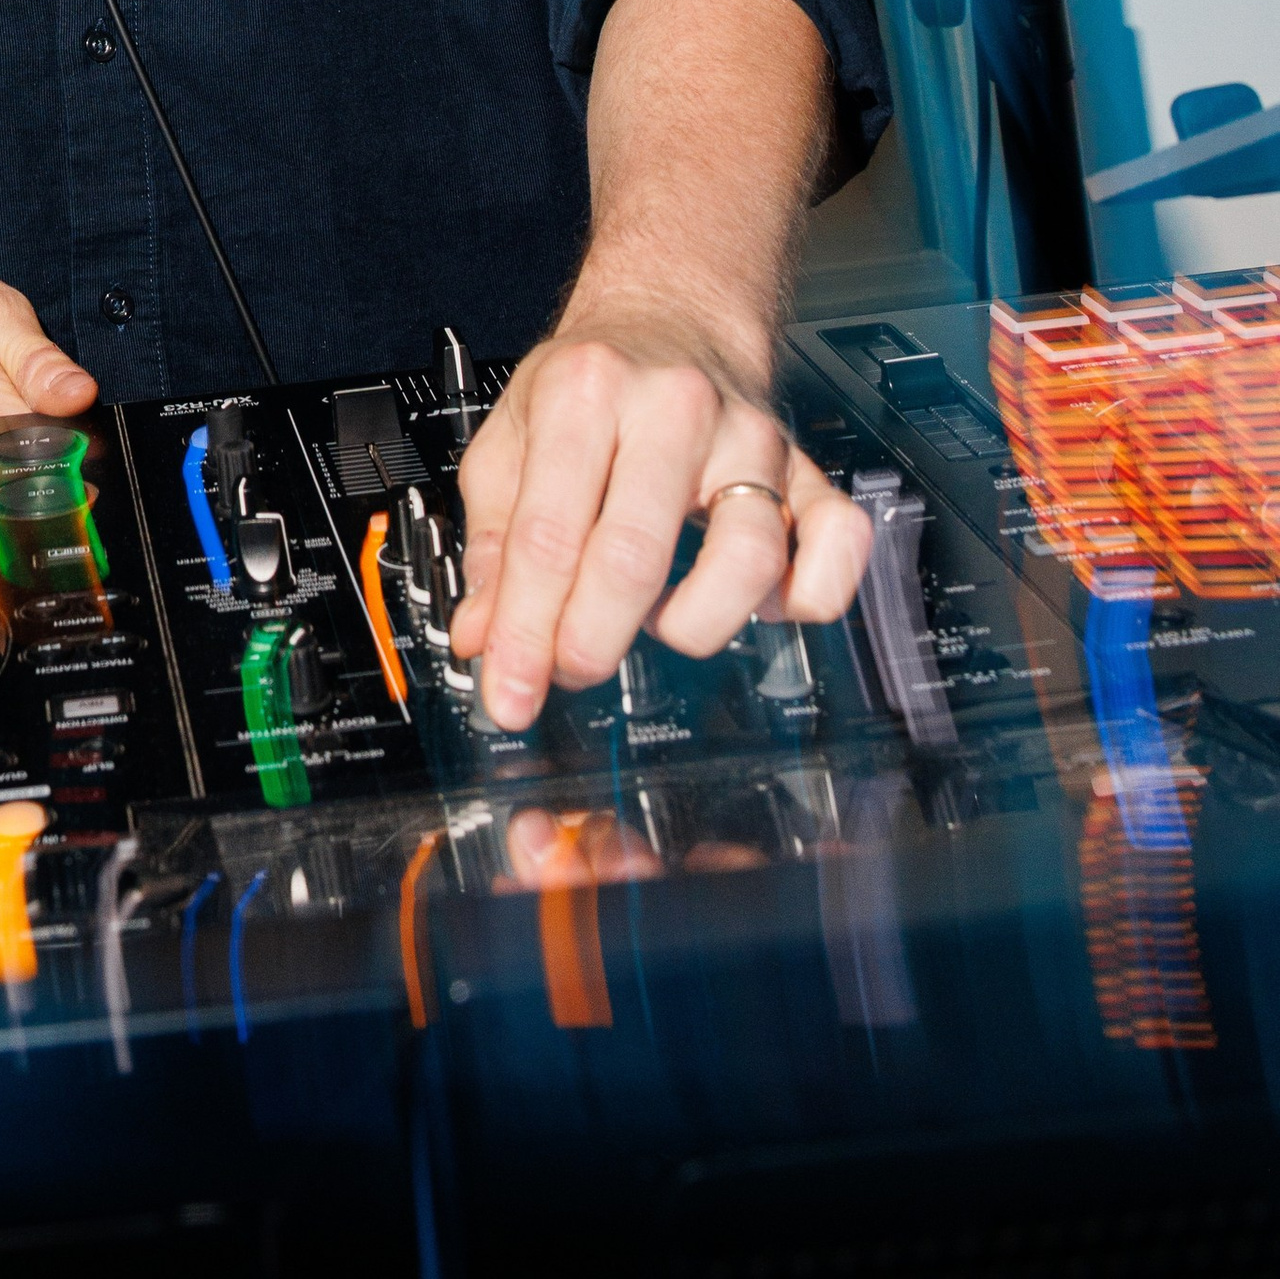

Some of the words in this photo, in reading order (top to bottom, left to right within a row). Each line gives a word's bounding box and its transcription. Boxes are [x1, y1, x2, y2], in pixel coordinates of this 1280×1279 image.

[1, 461, 71, 475] PLAY/PAUSE
[27, 488, 55, 497] CUE
[851, 489, 893, 502] SOUN
[53, 615, 104, 628] SEARCH
[35, 662, 88, 675] SEARCH
[91, 656, 133, 670] TRACK
